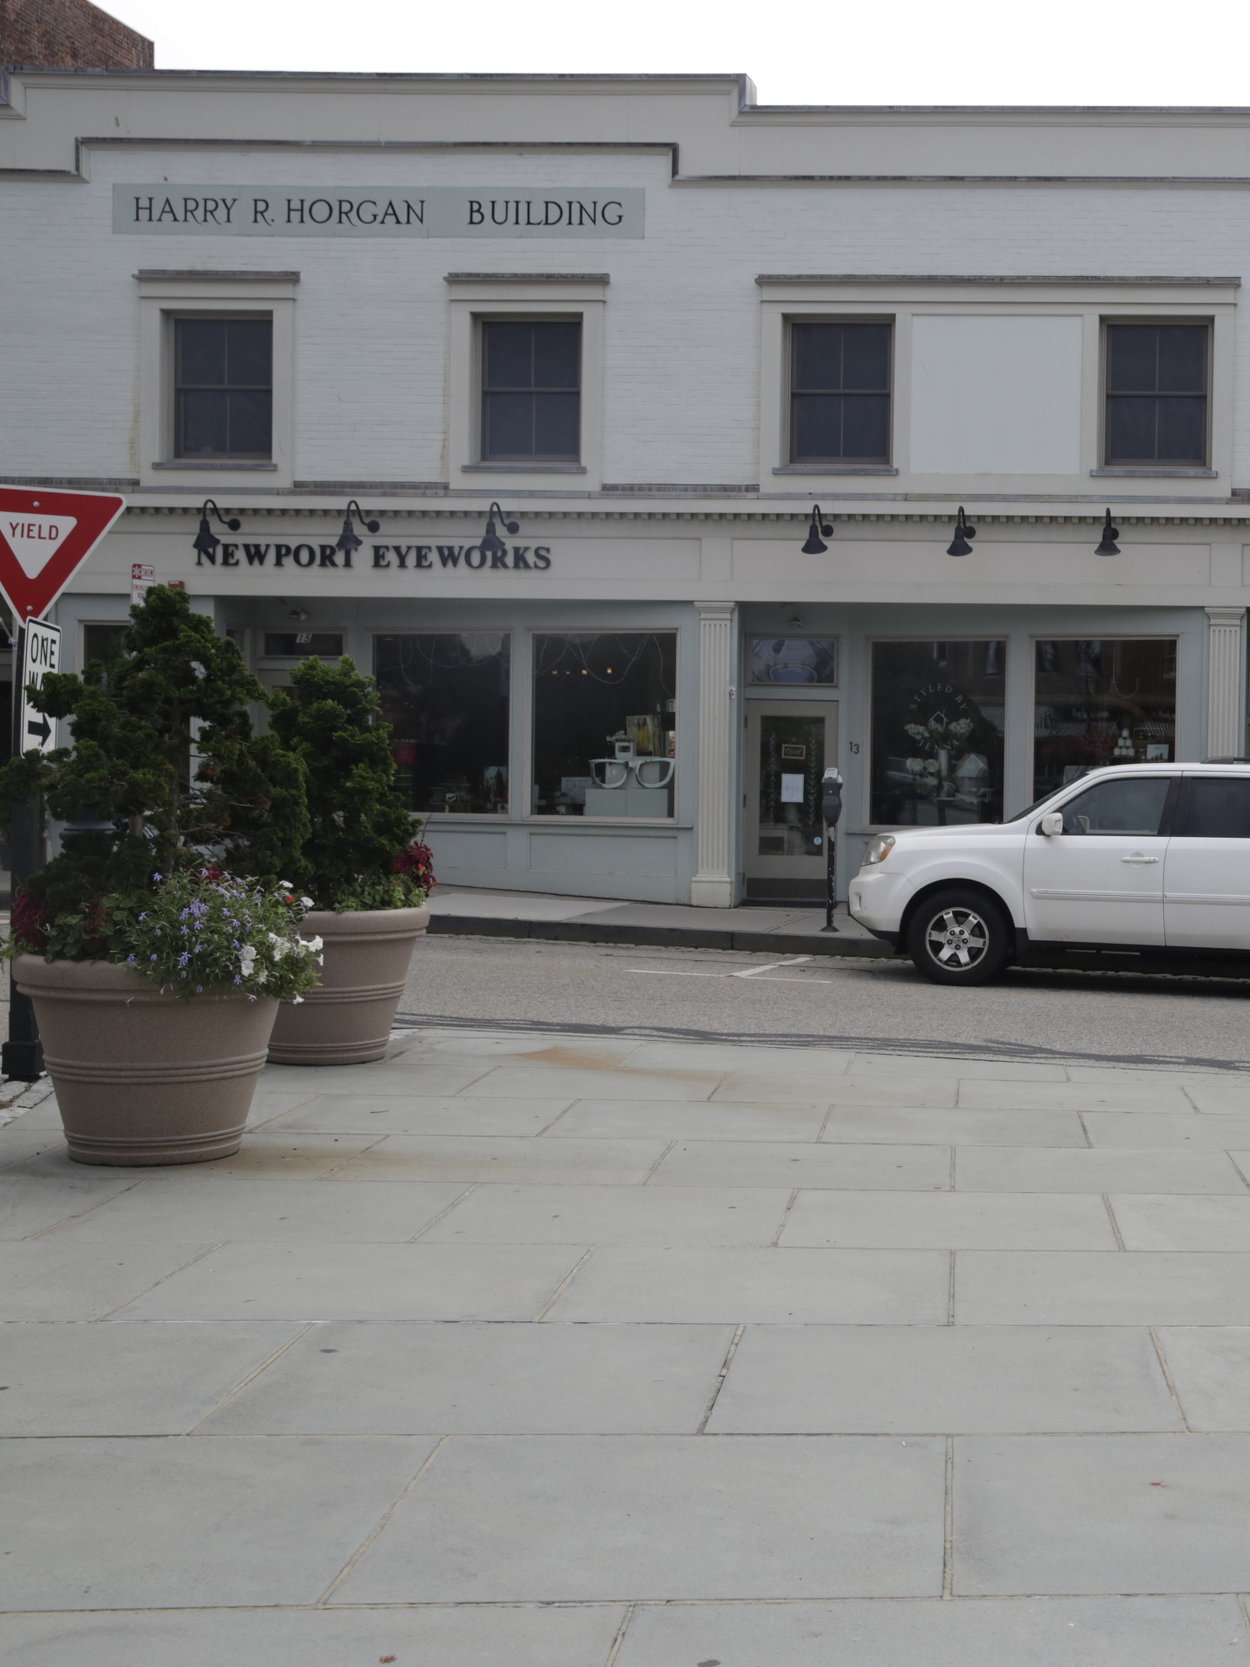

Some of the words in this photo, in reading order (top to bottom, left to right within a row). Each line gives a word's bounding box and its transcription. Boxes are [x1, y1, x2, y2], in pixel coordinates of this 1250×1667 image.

[133, 196, 239, 225] HARRY
[251, 198, 275, 225] R.
[286, 198, 427, 227] HORGAN
[466, 199, 625, 227] BUILDING
[9, 521, 59, 540] YIELD
[195, 543, 358, 568] NEWPORT
[371, 545, 552, 570] EYEWORKS
[30, 632, 57, 669] ONE
[909, 682, 953, 711] STYLED
[955, 694, 968, 710] BY
[849, 741, 860, 754] 13
